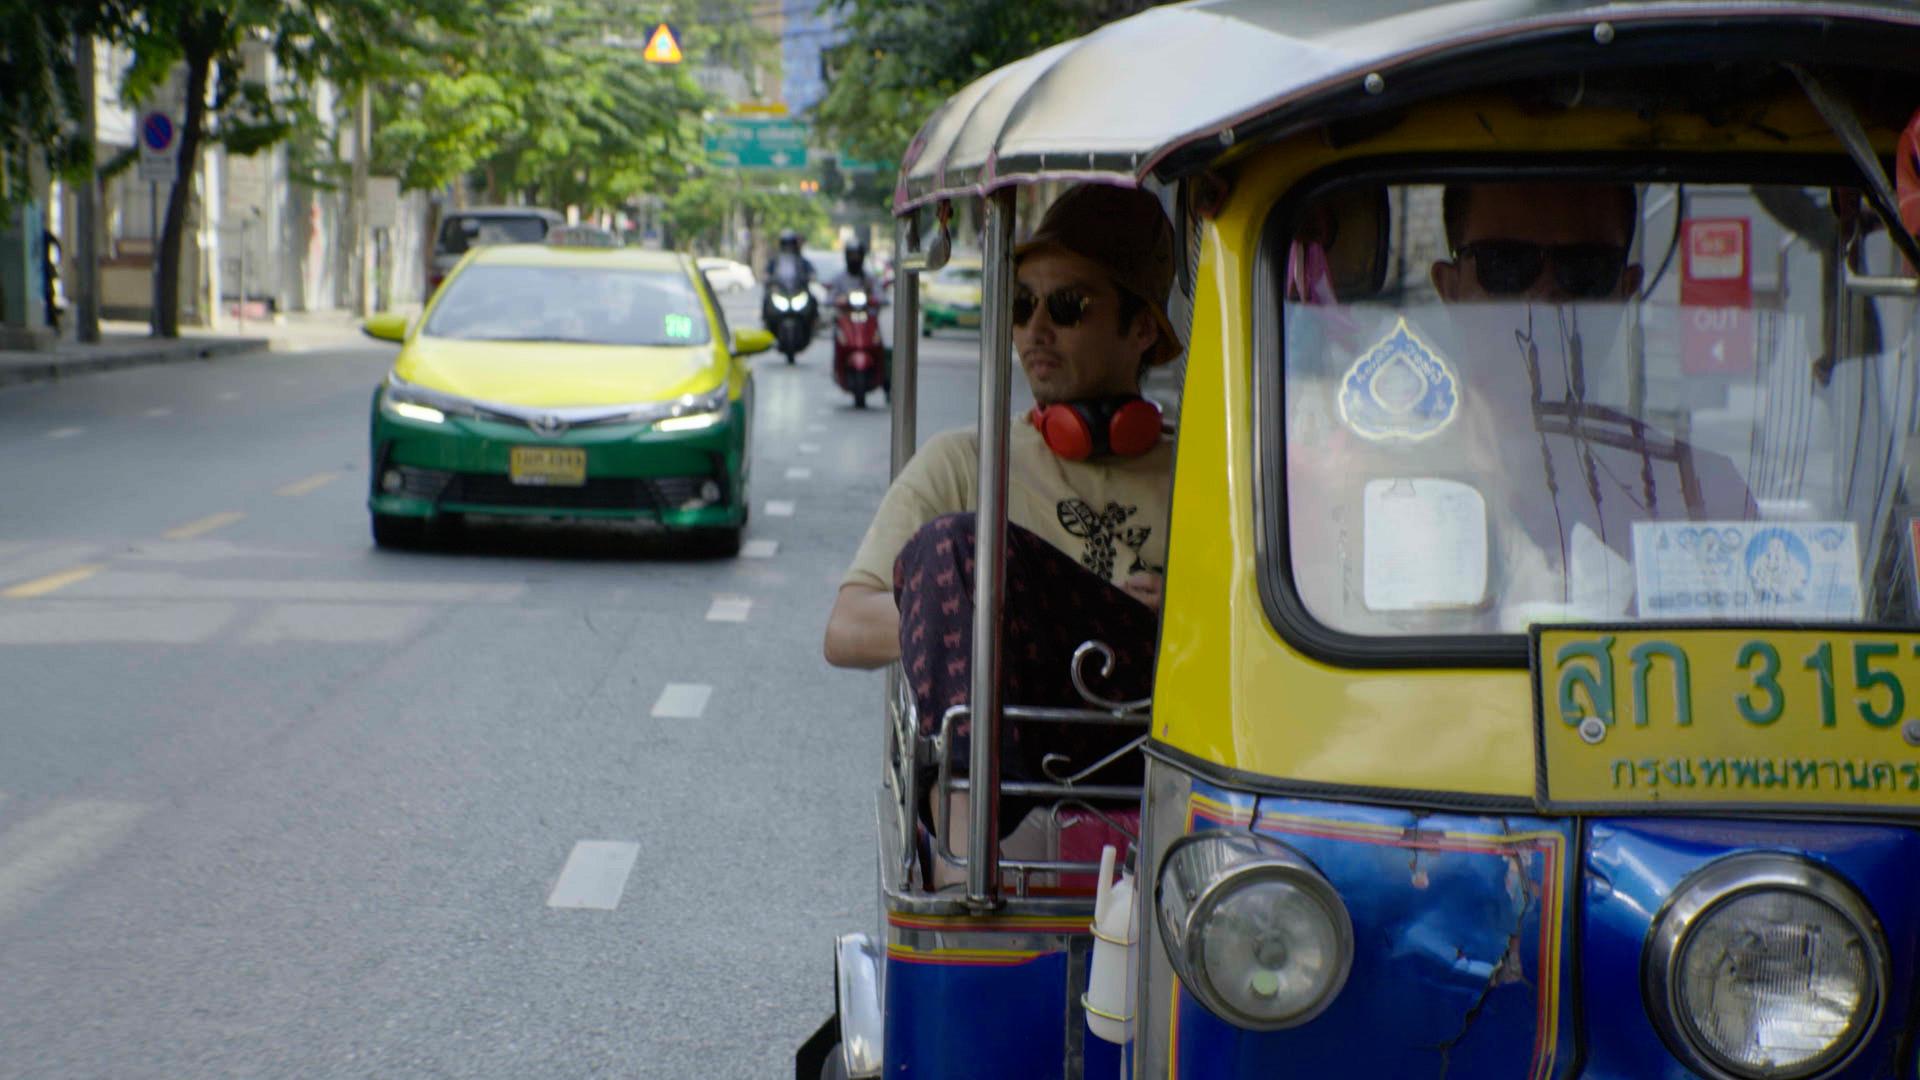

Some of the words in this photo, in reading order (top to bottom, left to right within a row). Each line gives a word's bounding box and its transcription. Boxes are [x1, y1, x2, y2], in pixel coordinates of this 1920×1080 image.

[1694, 308, 1739, 330] OUT
[1735, 638, 1920, 728] 315
[1611, 757, 1920, 799] กรุงเทพมหานคร
